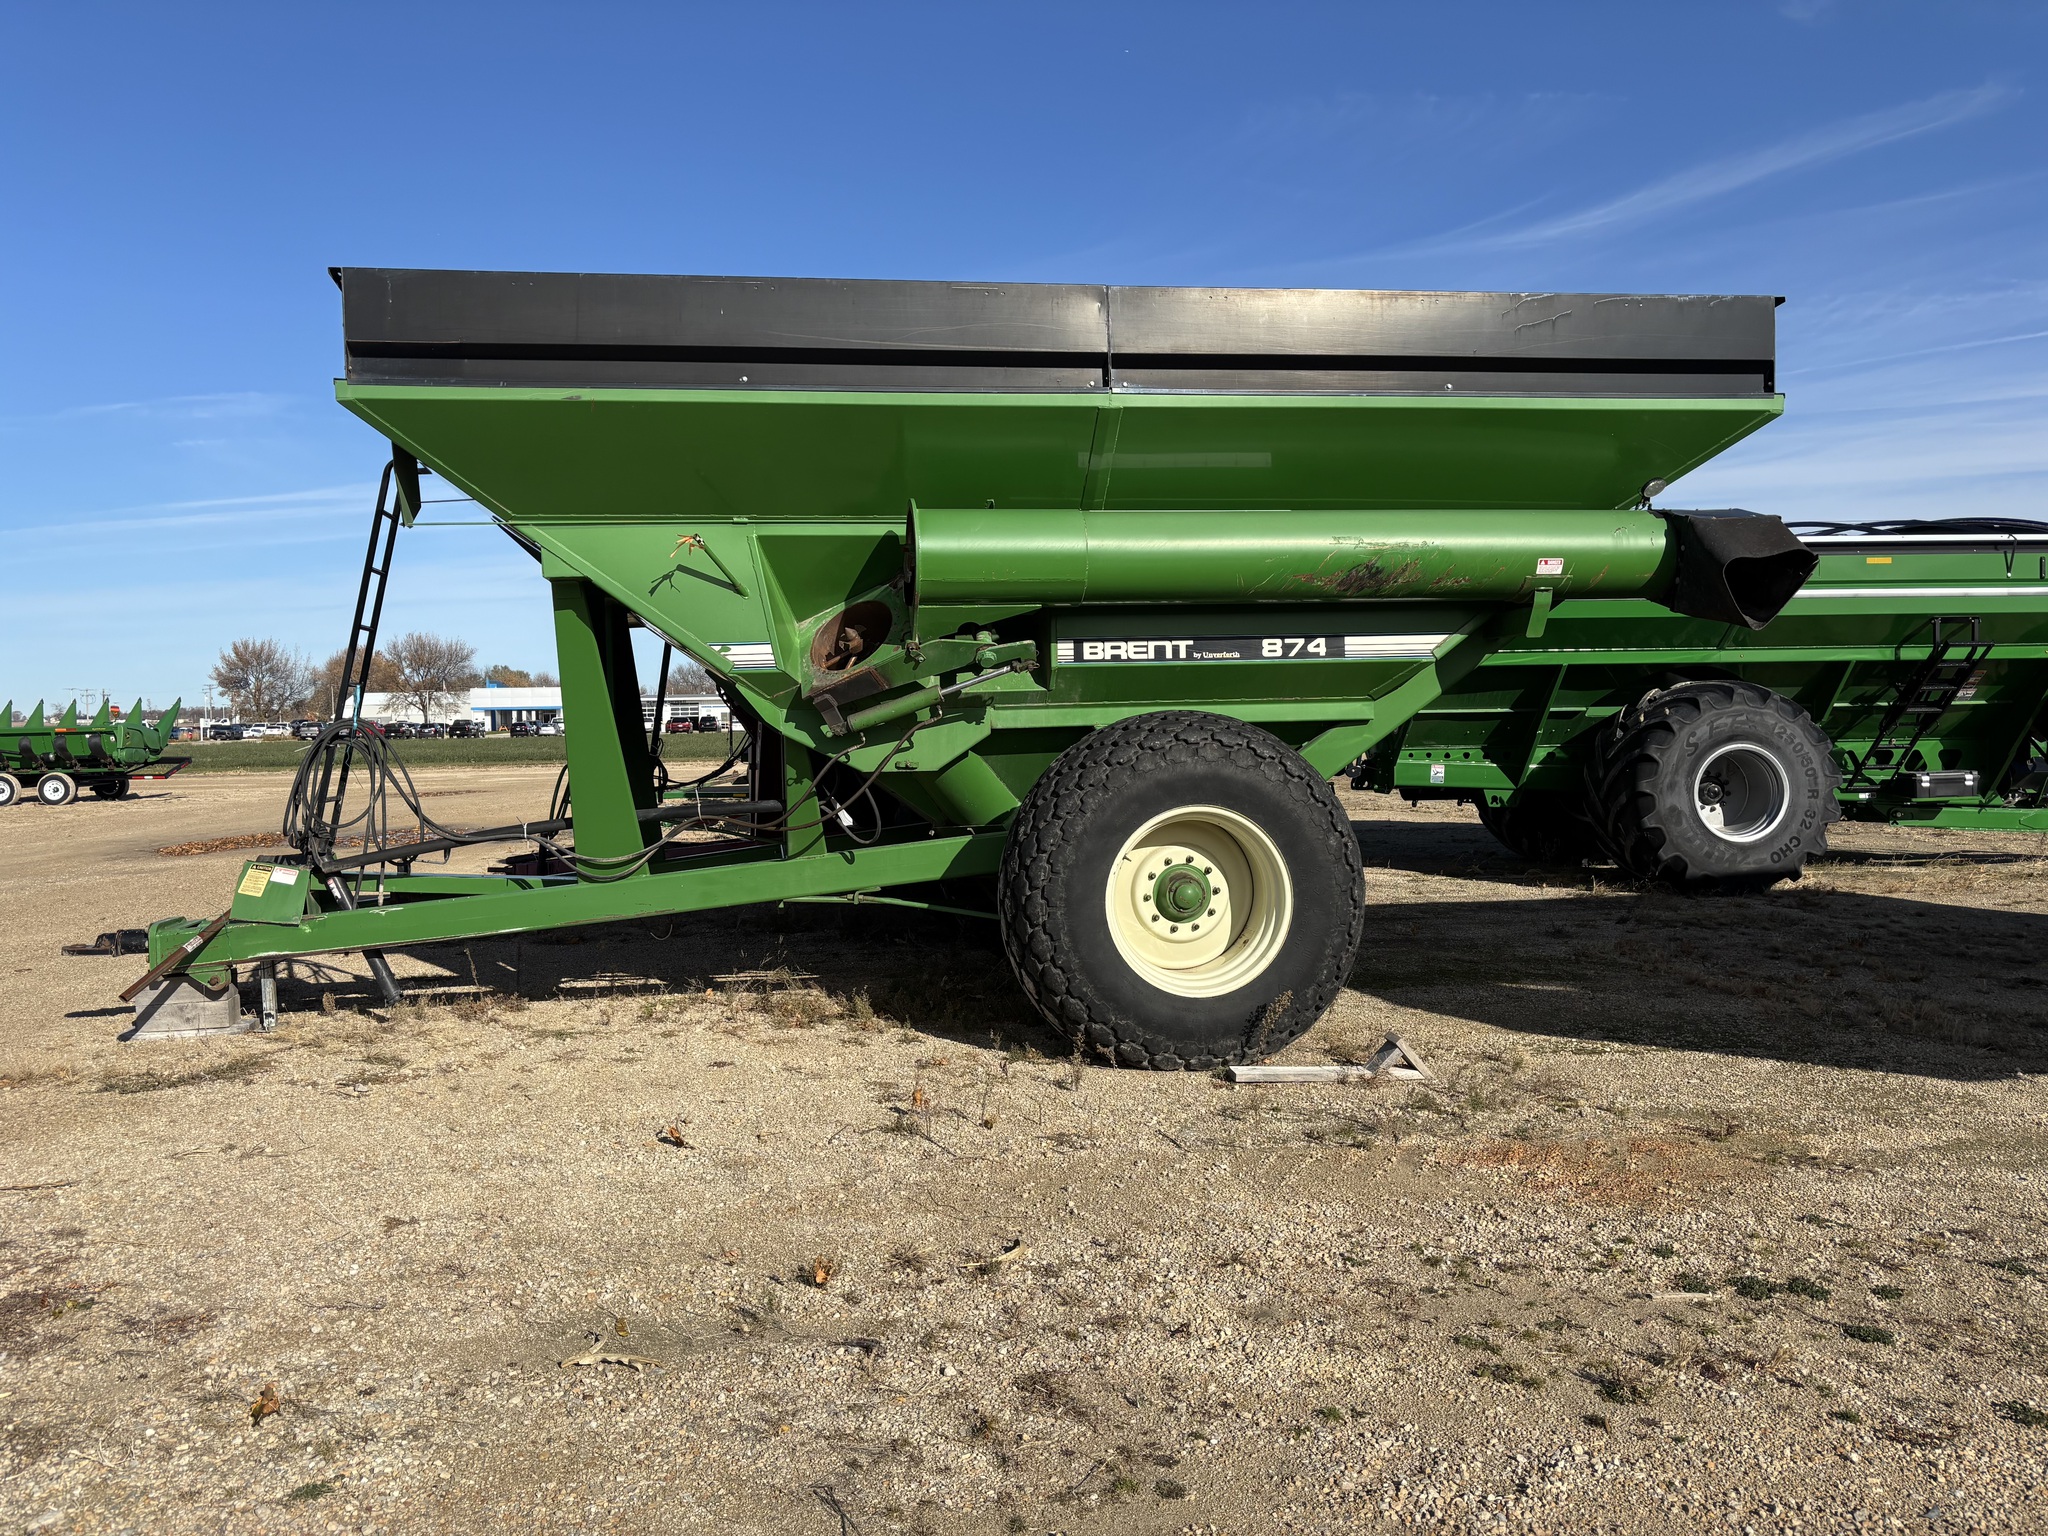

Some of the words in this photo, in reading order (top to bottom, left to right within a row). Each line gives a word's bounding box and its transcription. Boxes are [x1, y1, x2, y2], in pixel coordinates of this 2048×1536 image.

[1083, 640, 1193, 660] BRENT
[1262, 638, 1327, 657] 874
[1807, 788, 1820, 800] R
[1800, 808, 1817, 831] 32
[1769, 835, 1802, 865] CHO
